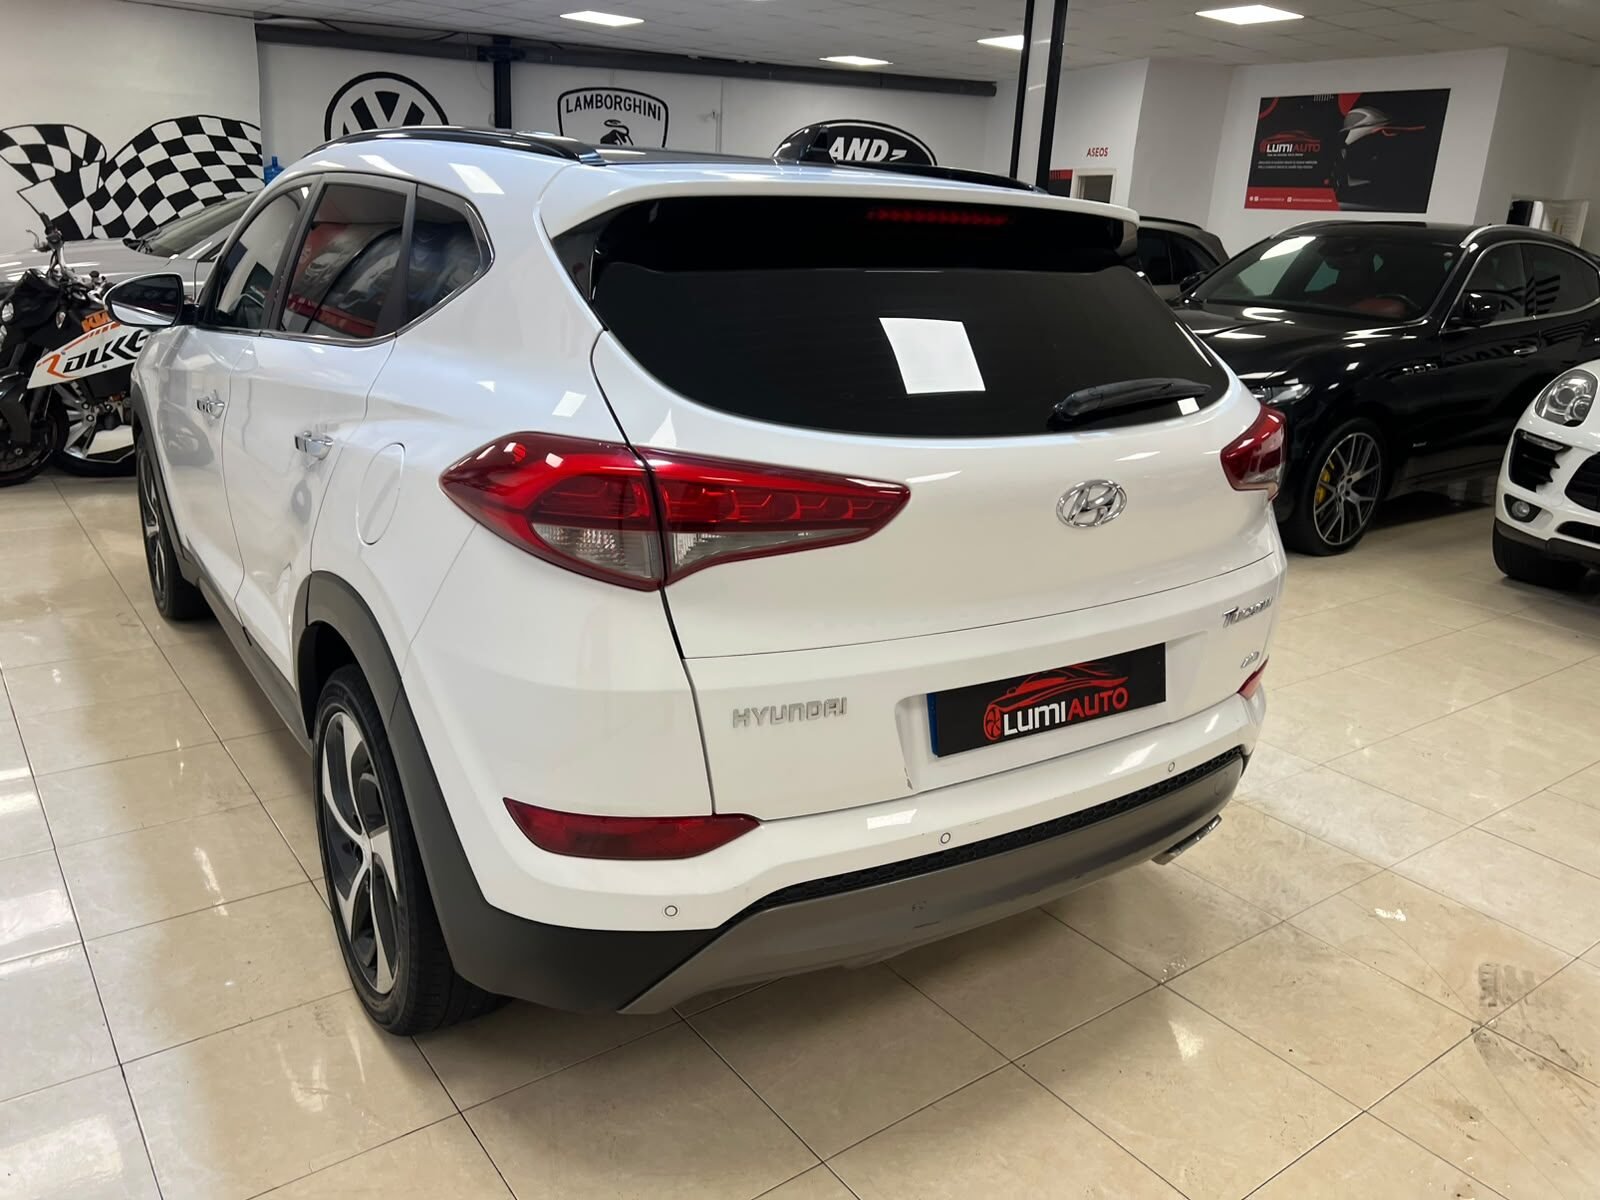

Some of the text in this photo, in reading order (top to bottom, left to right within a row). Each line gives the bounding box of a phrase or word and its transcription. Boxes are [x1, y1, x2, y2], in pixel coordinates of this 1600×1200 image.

[565, 93, 662, 122] LAMBORGHINI
[828, 136, 890, 162] AND
[1087, 147, 1109, 158] ASEOS
[732, 697, 848, 728] HYUNDAI
